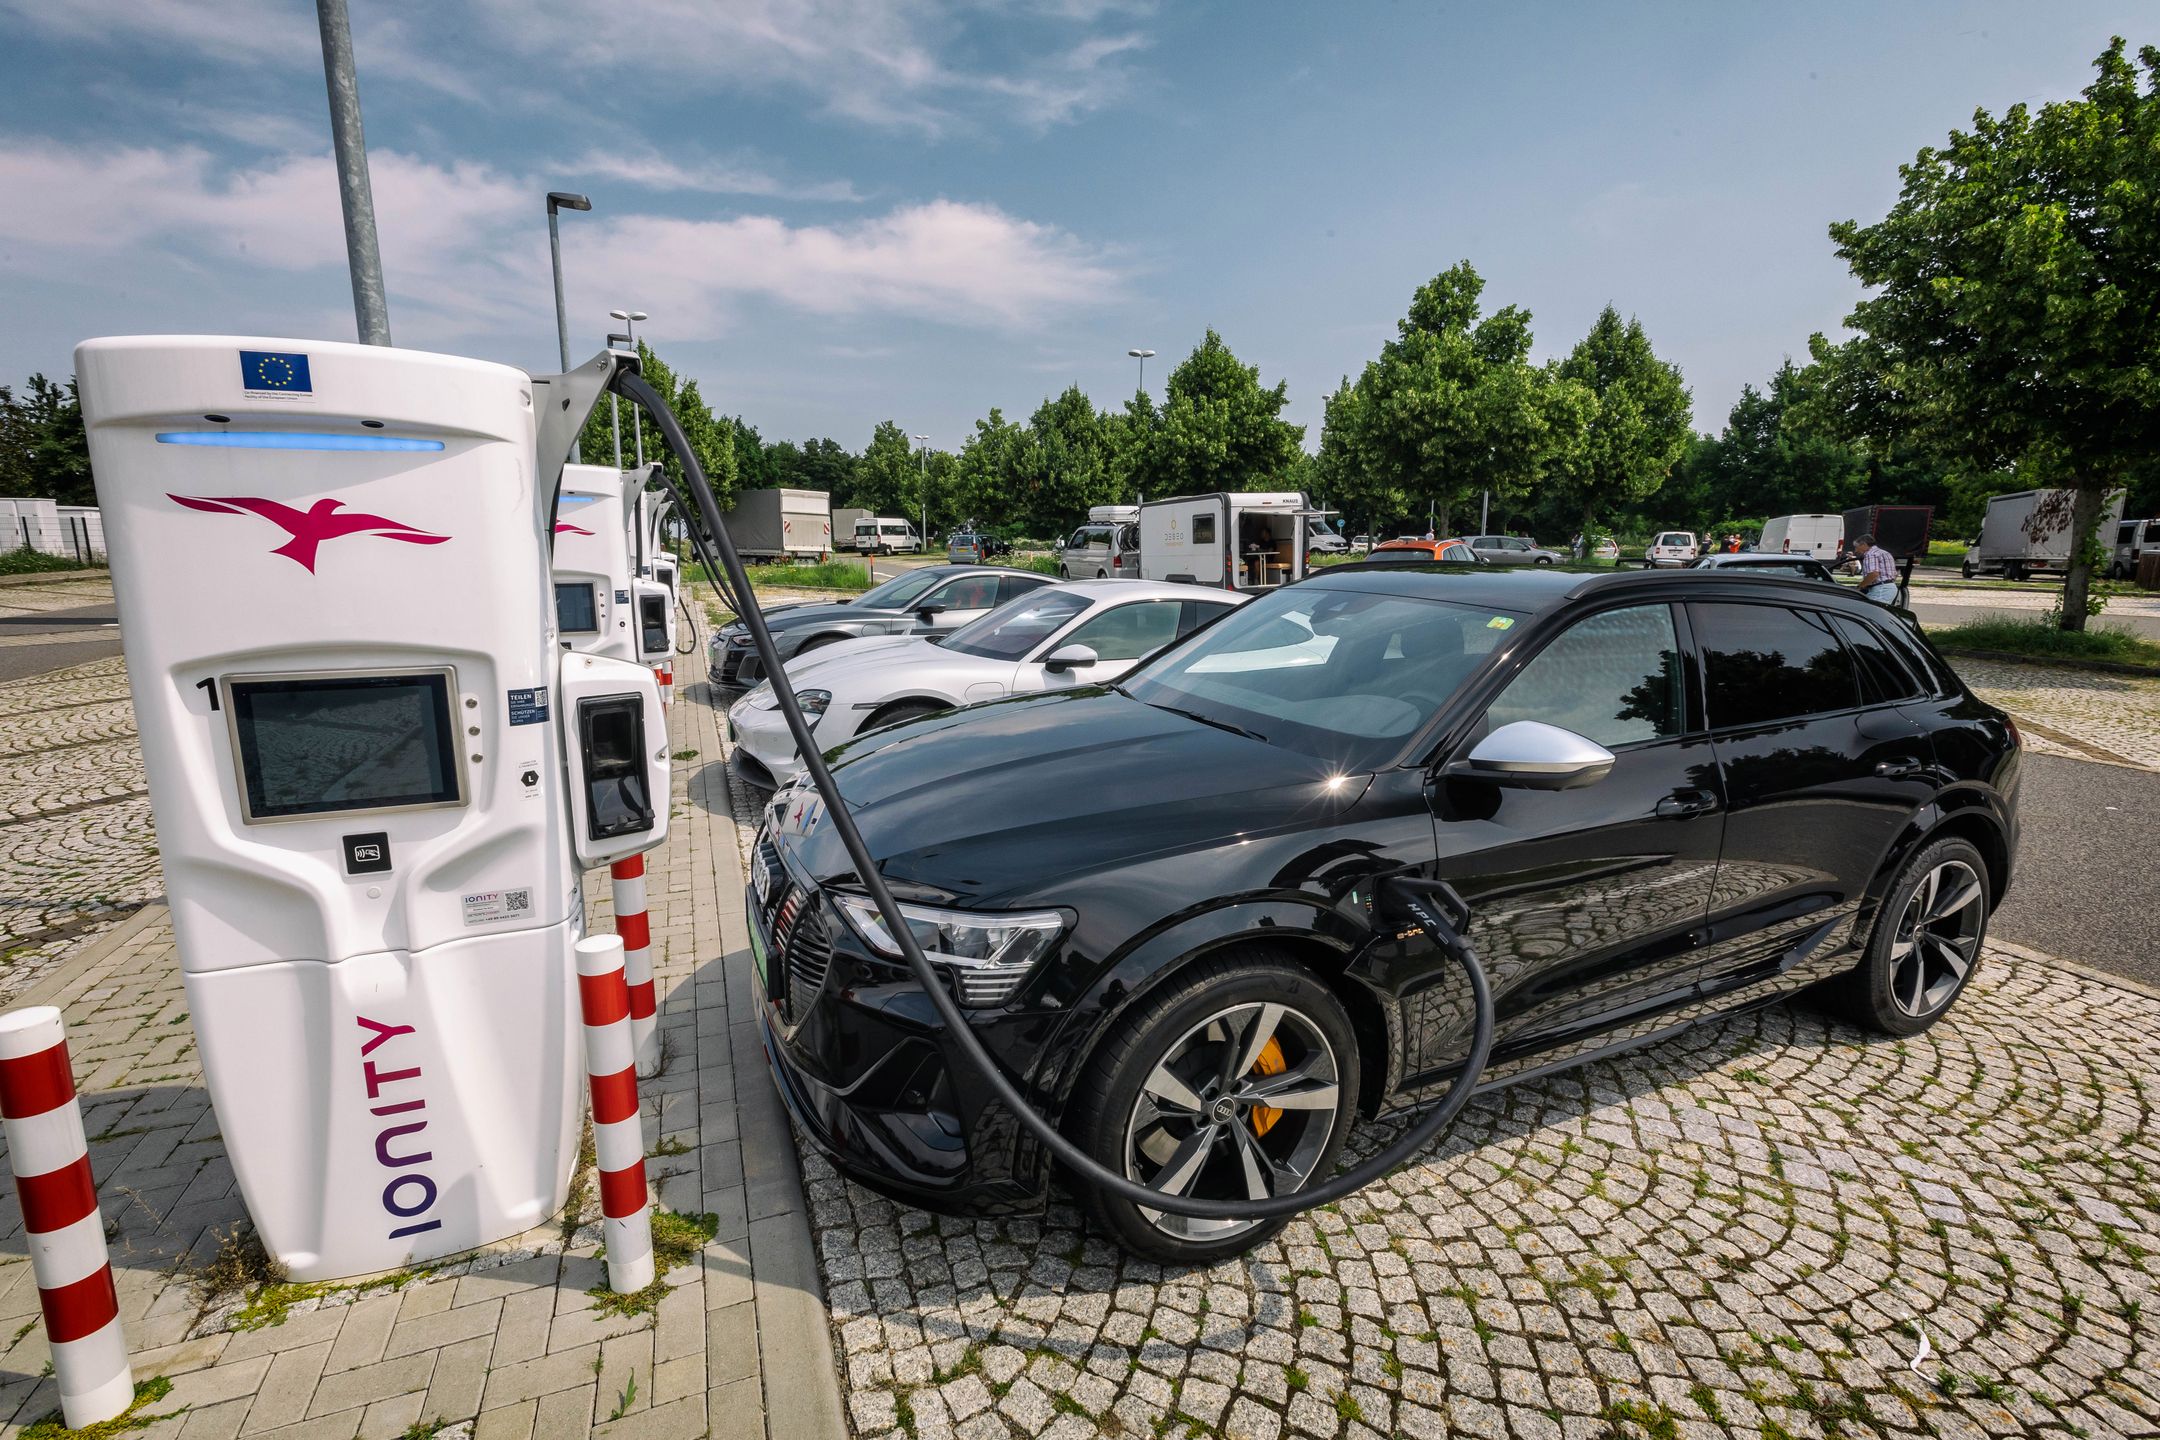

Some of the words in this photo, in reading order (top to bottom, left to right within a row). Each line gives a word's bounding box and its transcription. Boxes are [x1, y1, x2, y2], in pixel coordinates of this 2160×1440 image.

[196, 677, 220, 711] 1
[465, 894, 498, 903] IONITY
[1408, 903, 1437, 927] HPC
[356, 1015, 442, 1240] IONITY
